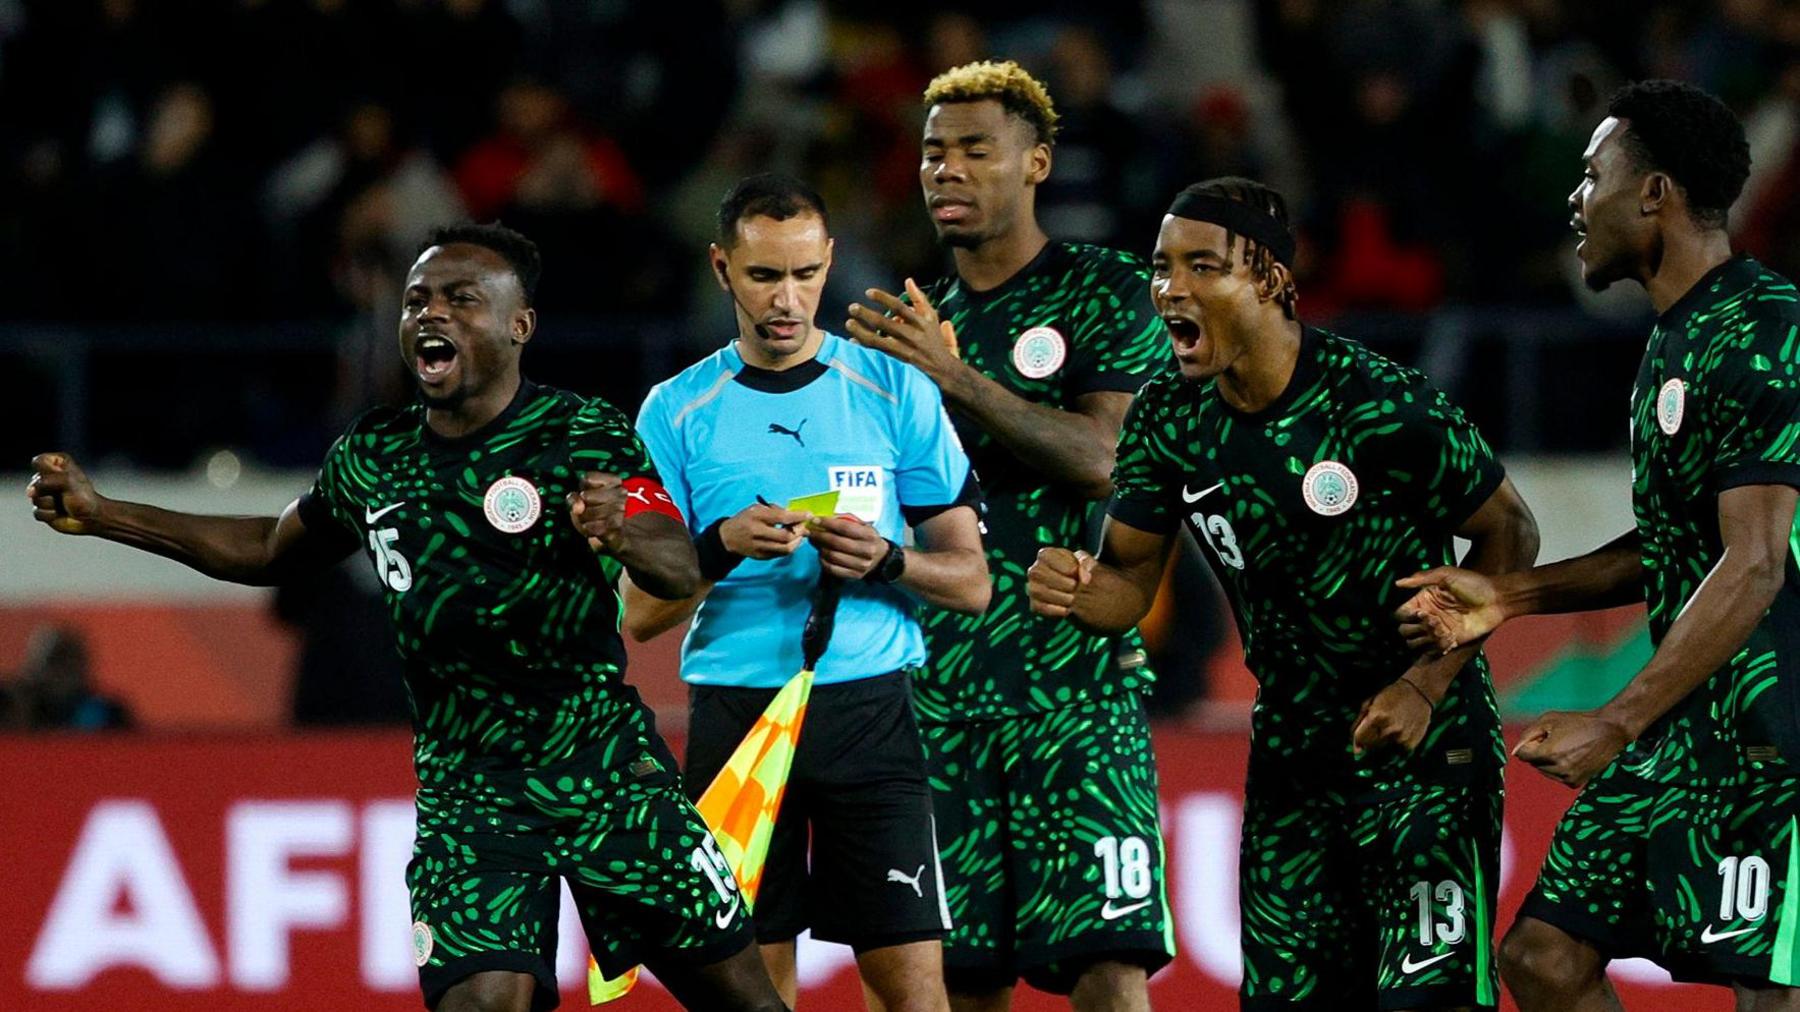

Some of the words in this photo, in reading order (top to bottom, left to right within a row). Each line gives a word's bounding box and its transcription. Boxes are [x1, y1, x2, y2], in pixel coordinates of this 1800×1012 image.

[834, 471, 877, 487] FIFA
[368, 527, 413, 592] 15
[1190, 511, 1245, 571] 13
[690, 829, 737, 904] 15
[1094, 835, 1152, 899] 18
[1717, 855, 1771, 921] 10
[1409, 879, 1466, 946] 13
